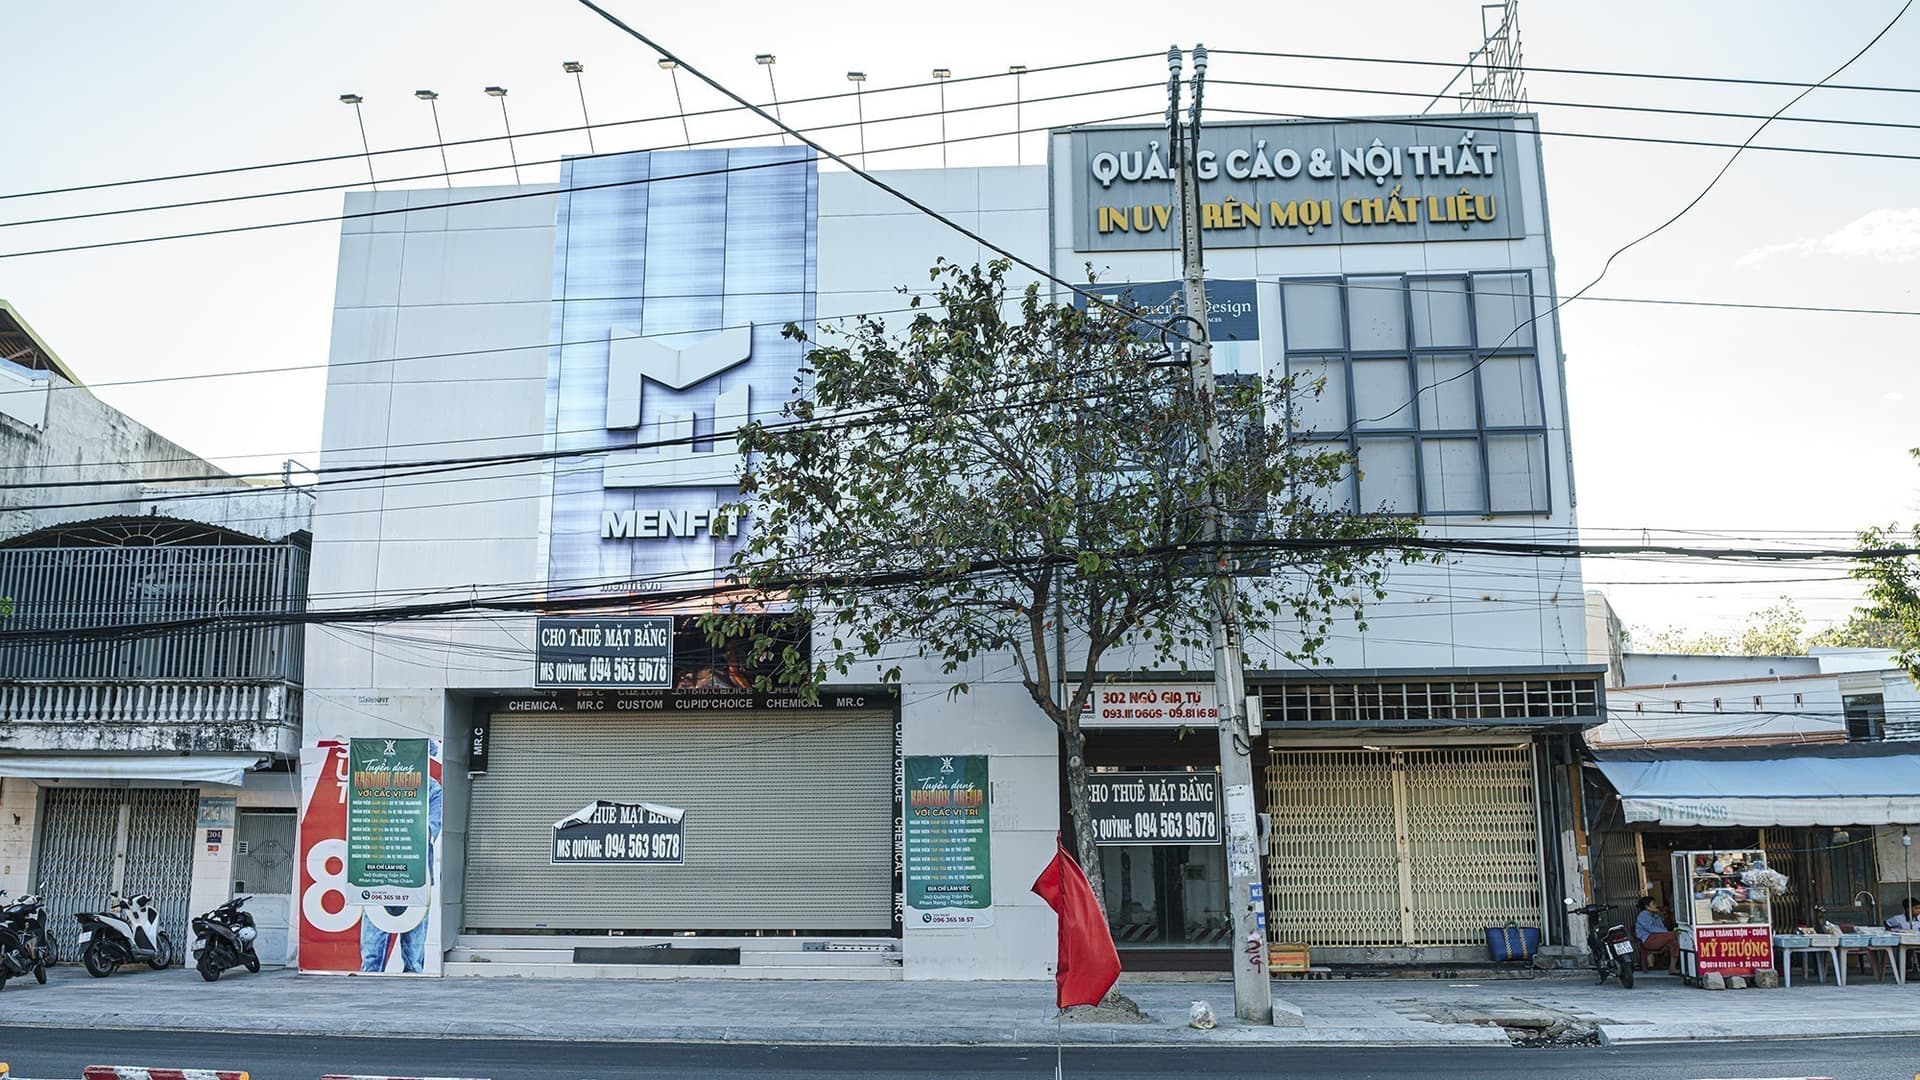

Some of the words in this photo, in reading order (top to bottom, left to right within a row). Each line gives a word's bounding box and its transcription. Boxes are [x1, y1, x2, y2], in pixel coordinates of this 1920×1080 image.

[1092, 140, 1218, 187] QUẢG
[1226, 139, 1301, 180] CÁO
[1308, 148, 1334, 178] &
[1340, 137, 1402, 185] NỘI
[1408, 130, 1497, 176] THẤT
[1099, 206, 1128, 233] IN
[1133, 205, 1173, 232] UV
[1203, 194, 1261, 230] RÊN
[1270, 200, 1332, 234] MỌI
[1342, 184, 1421, 225] CHẤT
[1427, 185, 1496, 231] LIỆU
[541, 628, 566, 647] CHO
[569, 623, 601, 647] THUÊ
[604, 623, 632, 652] MẶT
[634, 621, 667, 647] BẰNG
[540, 662, 554, 681] MS
[556, 658, 587, 683] QUỲNH:
[589, 657, 612, 681] 094
[614, 657, 636, 681] 563
[639, 657, 667, 681] 9678
[577, 700, 604, 710] MR.C
[617, 700, 663, 710] CUSTOM
[675, 698, 753, 709] CUPID'CHOICE
[767, 698, 823, 708] CHEMICAL
[836, 697, 865, 707] MR.C
[1103, 691, 1126, 704] 302
[1129, 689, 1157, 704] NGÔ
[1161, 691, 1182, 704] GIA
[473, 727, 484, 755] MR.C
[357, 787, 371, 797] VỚI
[374, 787, 390, 797] CÁC
[393, 790, 401, 799] VỊ
[404, 787, 417, 797] TRÍ
[1112, 778, 1145, 802] THUÊ
[1149, 778, 1176, 806] MẶT
[1179, 776, 1213, 802] BẰNG
[914, 806, 930, 816] VỚI
[932, 806, 950, 816] CÁC
[953, 809, 962, 817] VỊ
[965, 806, 978, 816] TRÍ
[1100, 815, 1132, 840] QUỲNH:
[1135, 812, 1157, 837] 094
[1160, 812, 1182, 837] 563
[1185, 812, 1215, 837] 9678
[557, 840, 570, 857] MS
[572, 836, 602, 859] QUỲNH:
[605, 834, 626, 857] 094
[628, 834, 649, 858] 563
[652, 834, 680, 858] 9678
[895, 817, 904, 877] CHEMICAL
[895, 892, 904, 923] MR.C
[1700, 938, 1718, 957] MỸ
[1720, 938, 1769, 960] PHƯỢNG
